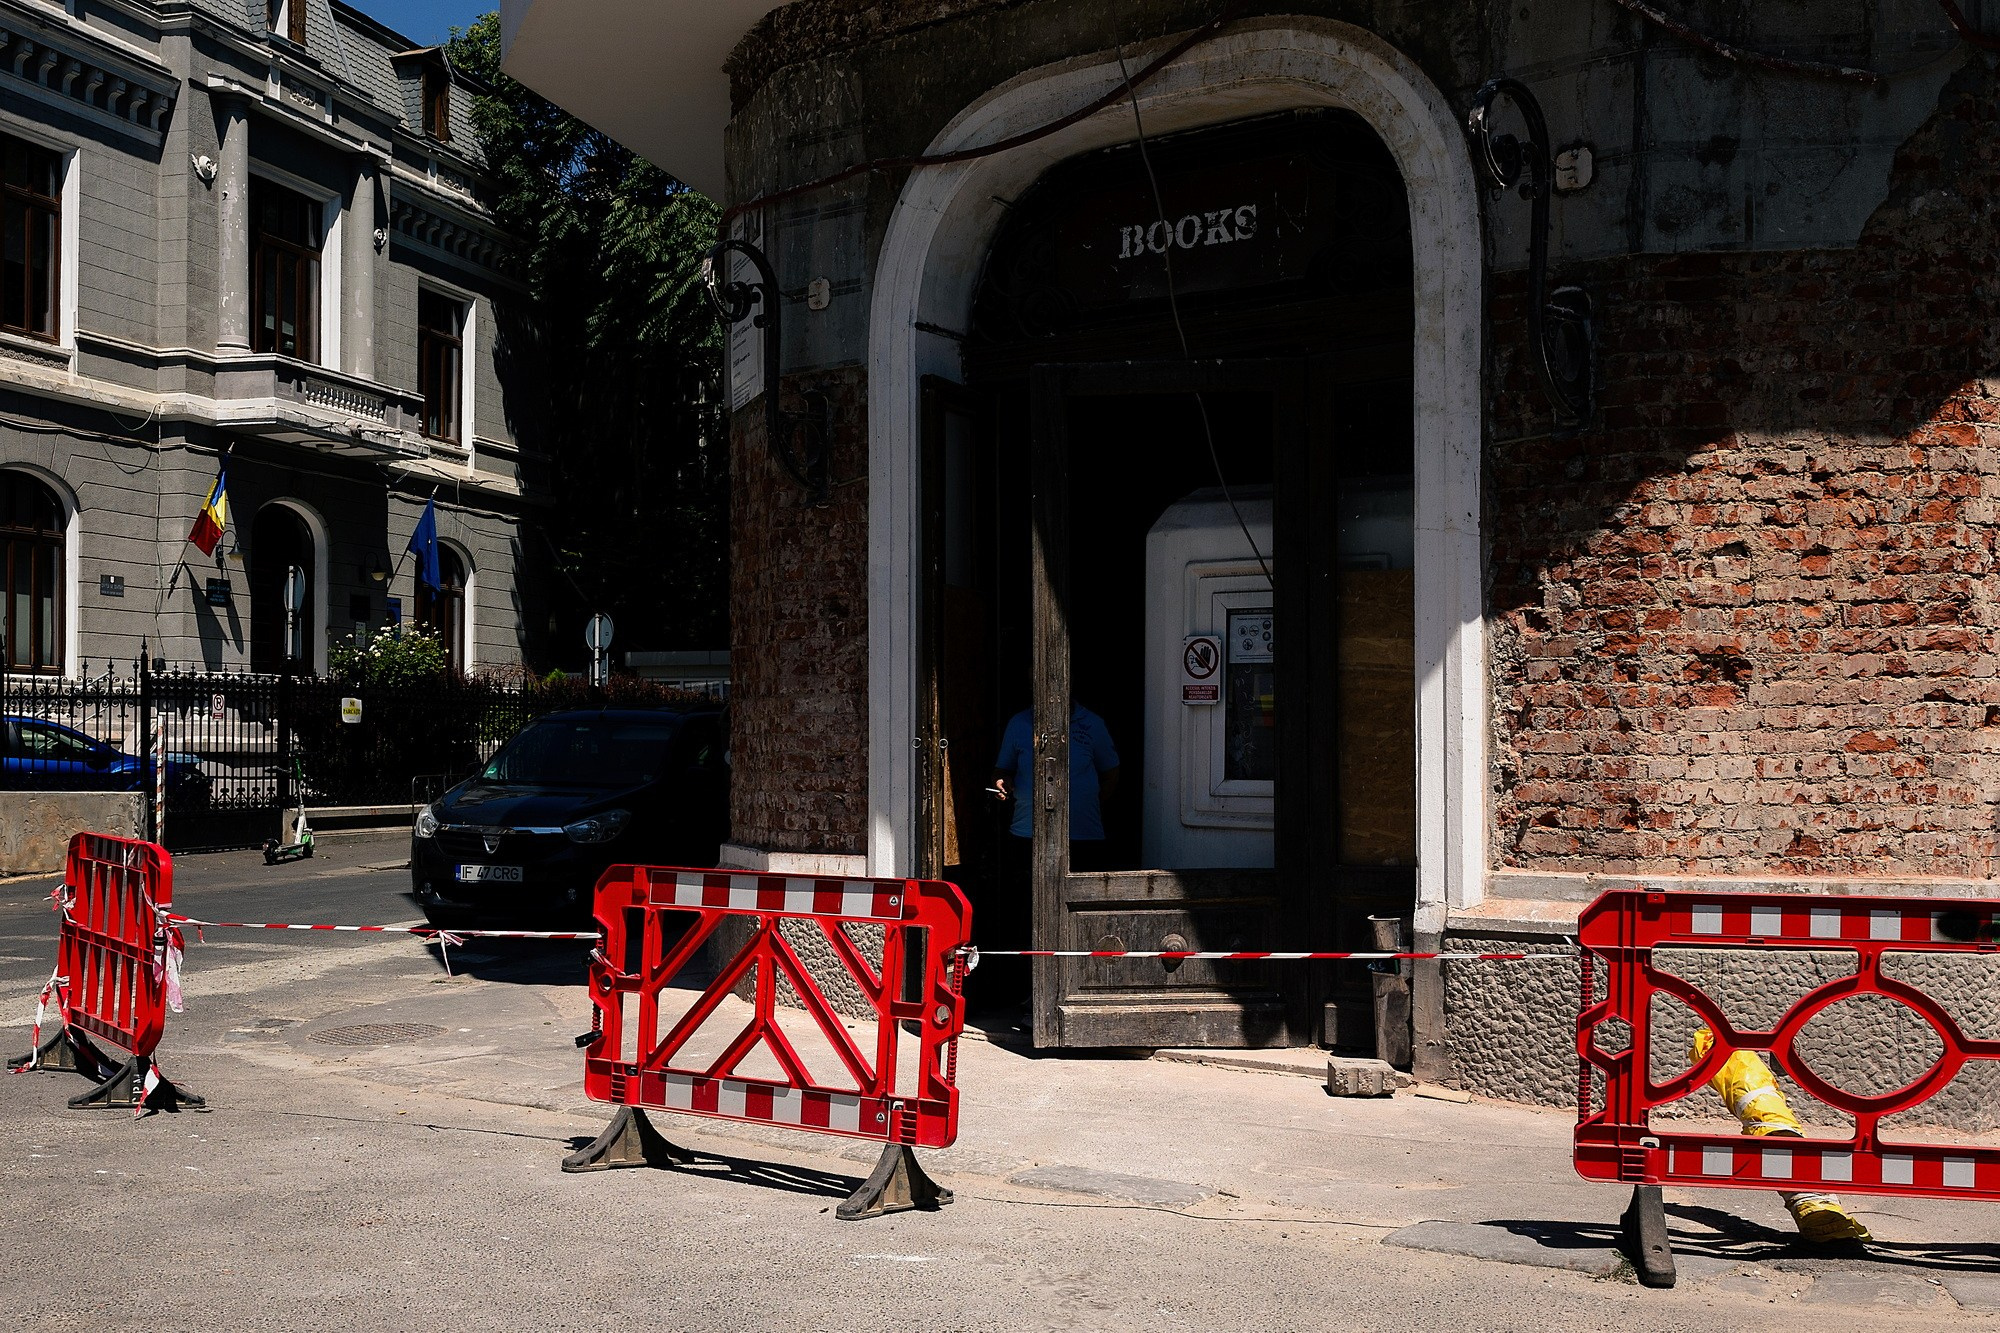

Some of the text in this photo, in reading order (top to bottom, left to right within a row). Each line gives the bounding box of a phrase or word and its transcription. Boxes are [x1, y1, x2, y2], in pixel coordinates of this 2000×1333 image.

[1119, 203, 1257, 259] BOOKS
[462, 866, 474, 878] IF
[477, 866, 491, 879] 47
[493, 867, 519, 880] CRG
